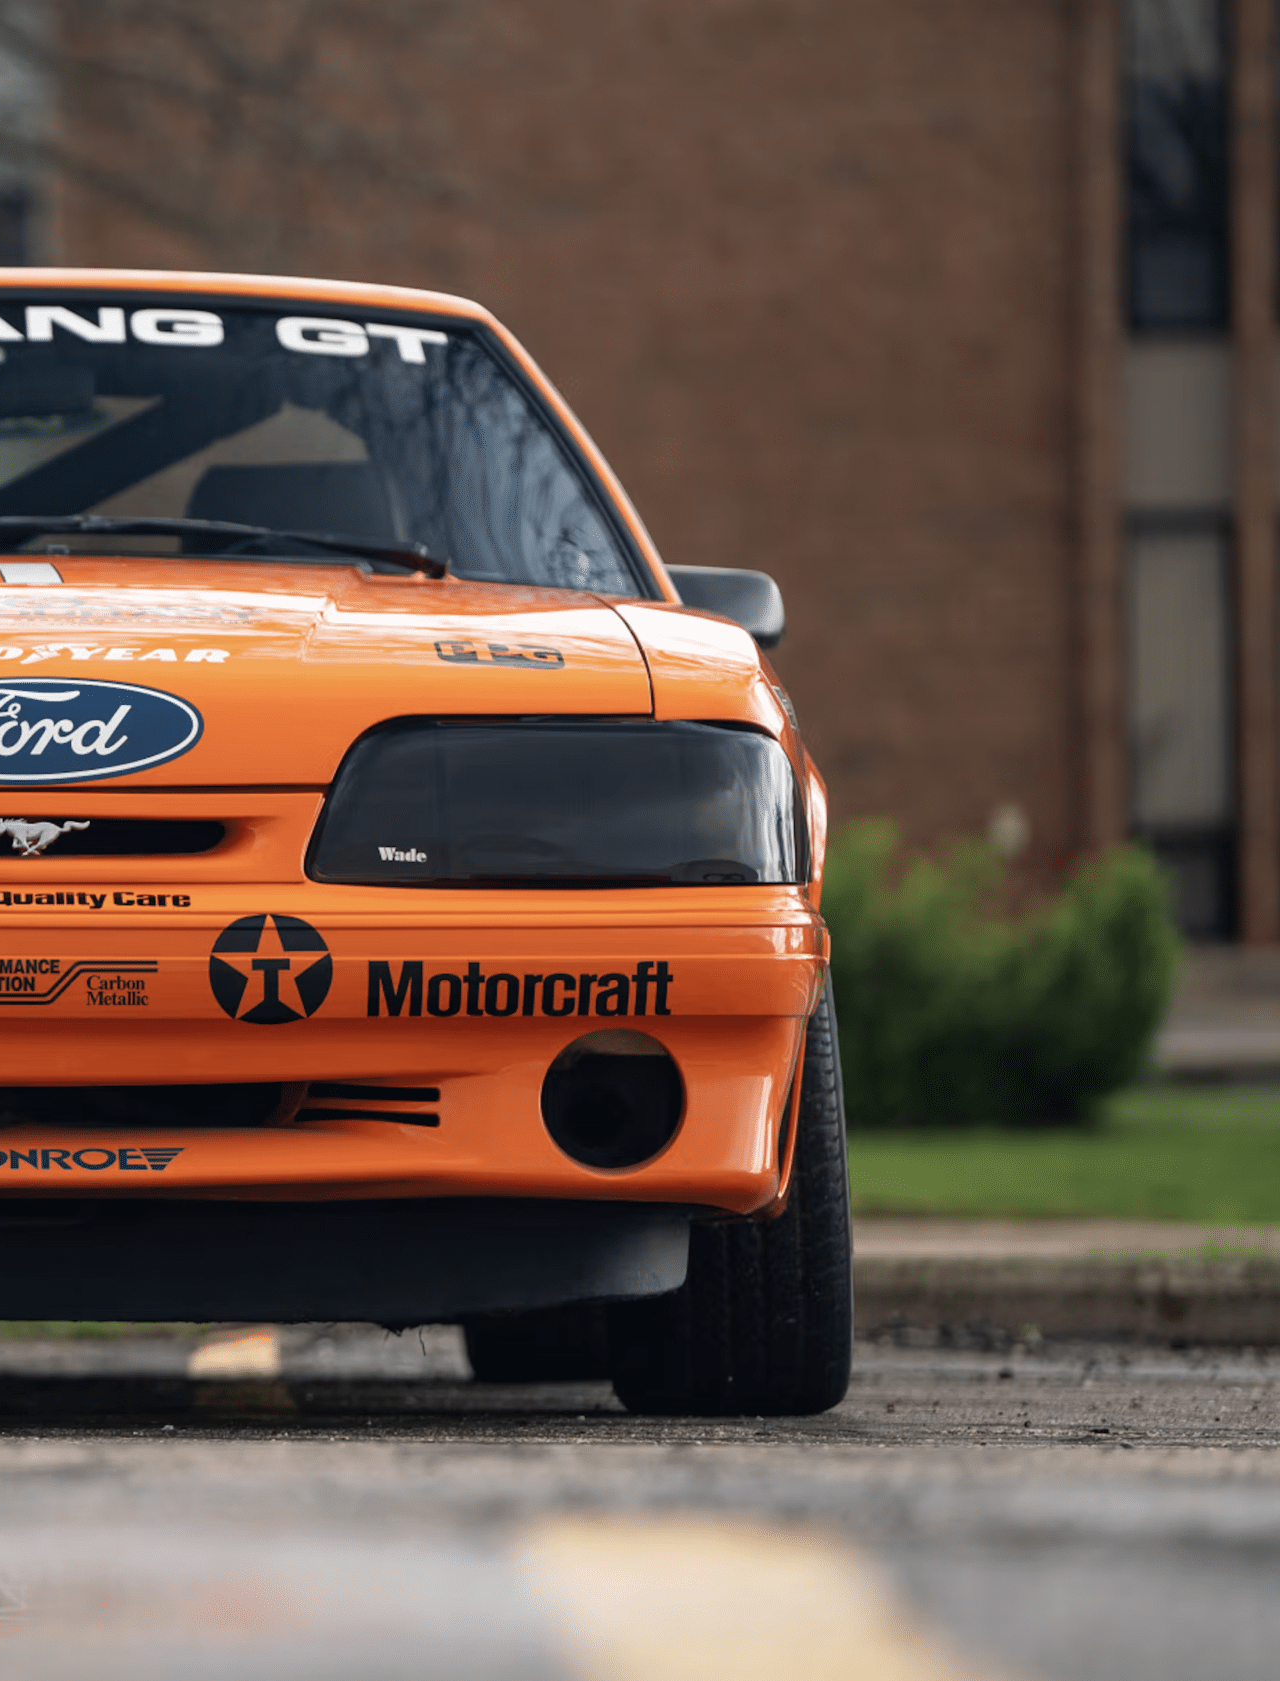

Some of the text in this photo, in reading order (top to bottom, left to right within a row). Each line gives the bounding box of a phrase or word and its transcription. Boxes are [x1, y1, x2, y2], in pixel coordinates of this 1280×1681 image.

[276, 316, 449, 364] GT
[377, 846, 428, 863] Wade
[113, 891, 192, 907] Care
[86, 974, 146, 991] Carbon
[366, 960, 674, 1017] Motorcraft
[86, 991, 150, 1006] Metallic
